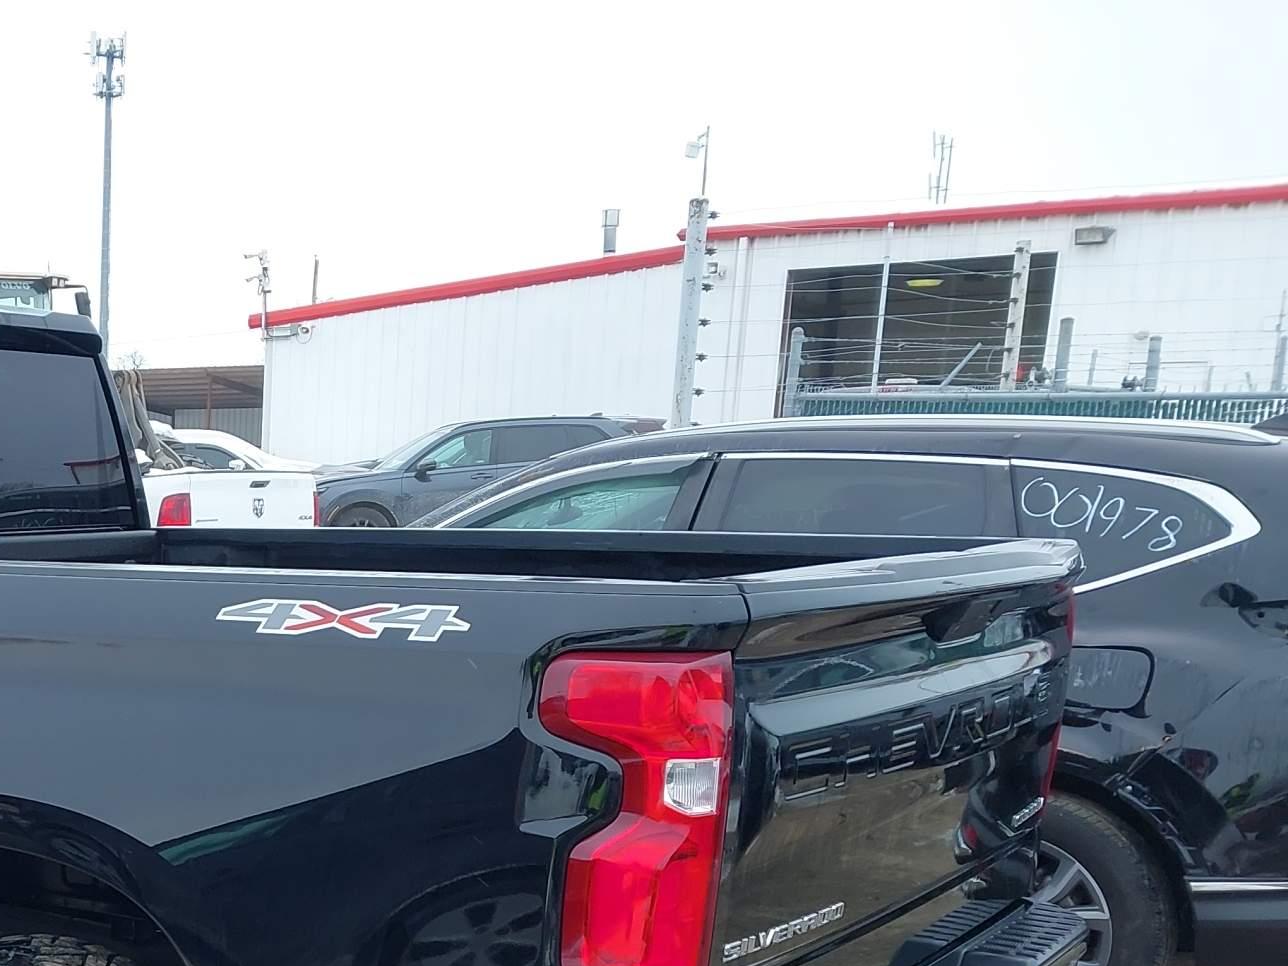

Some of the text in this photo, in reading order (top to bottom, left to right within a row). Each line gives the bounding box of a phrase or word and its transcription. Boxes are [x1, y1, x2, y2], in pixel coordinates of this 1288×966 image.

[1021, 477, 1183, 552] 001978
[216, 599, 471, 642] 4X4
[784, 668, 1052, 801] CHEVROLE
[722, 902, 844, 962] SILVERADO
